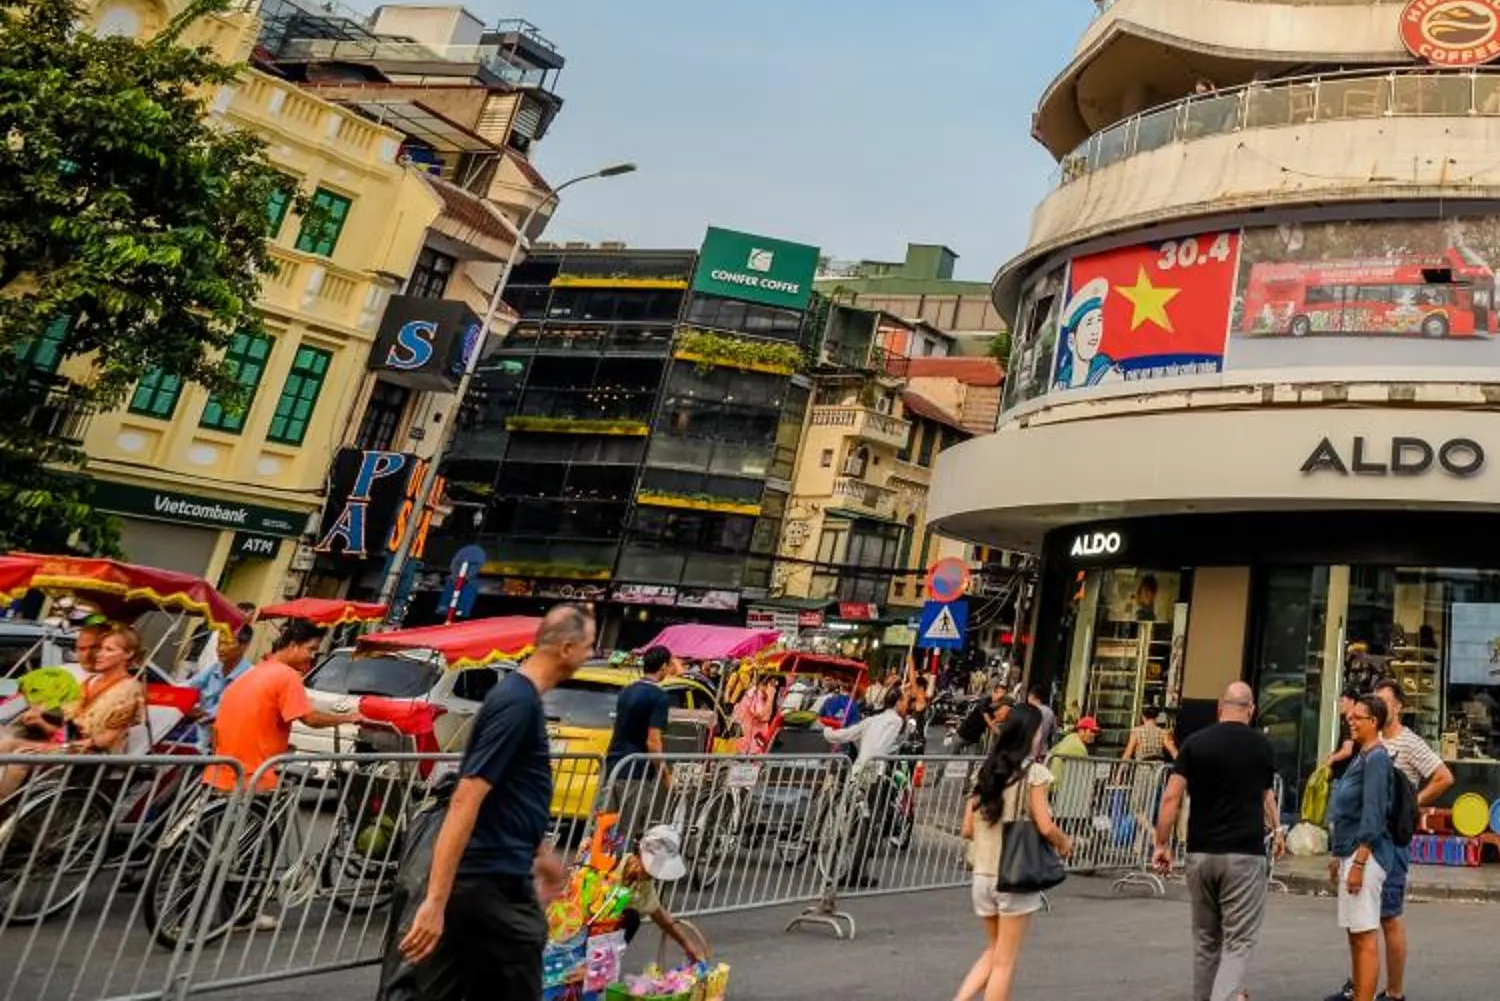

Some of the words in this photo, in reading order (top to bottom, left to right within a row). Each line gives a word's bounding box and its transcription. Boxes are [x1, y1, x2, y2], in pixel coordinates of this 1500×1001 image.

[1419, 39, 1500, 64] COFFEE
[1157, 233, 1232, 271] 30.4
[711, 269, 759, 287] CONIFER
[760, 278, 800, 294] COFFEE
[1299, 435, 1486, 477] ALDO
[154, 494, 249, 524] Vietcombank
[241, 536, 274, 554] ATM
[1071, 531, 1121, 556] ALDO
